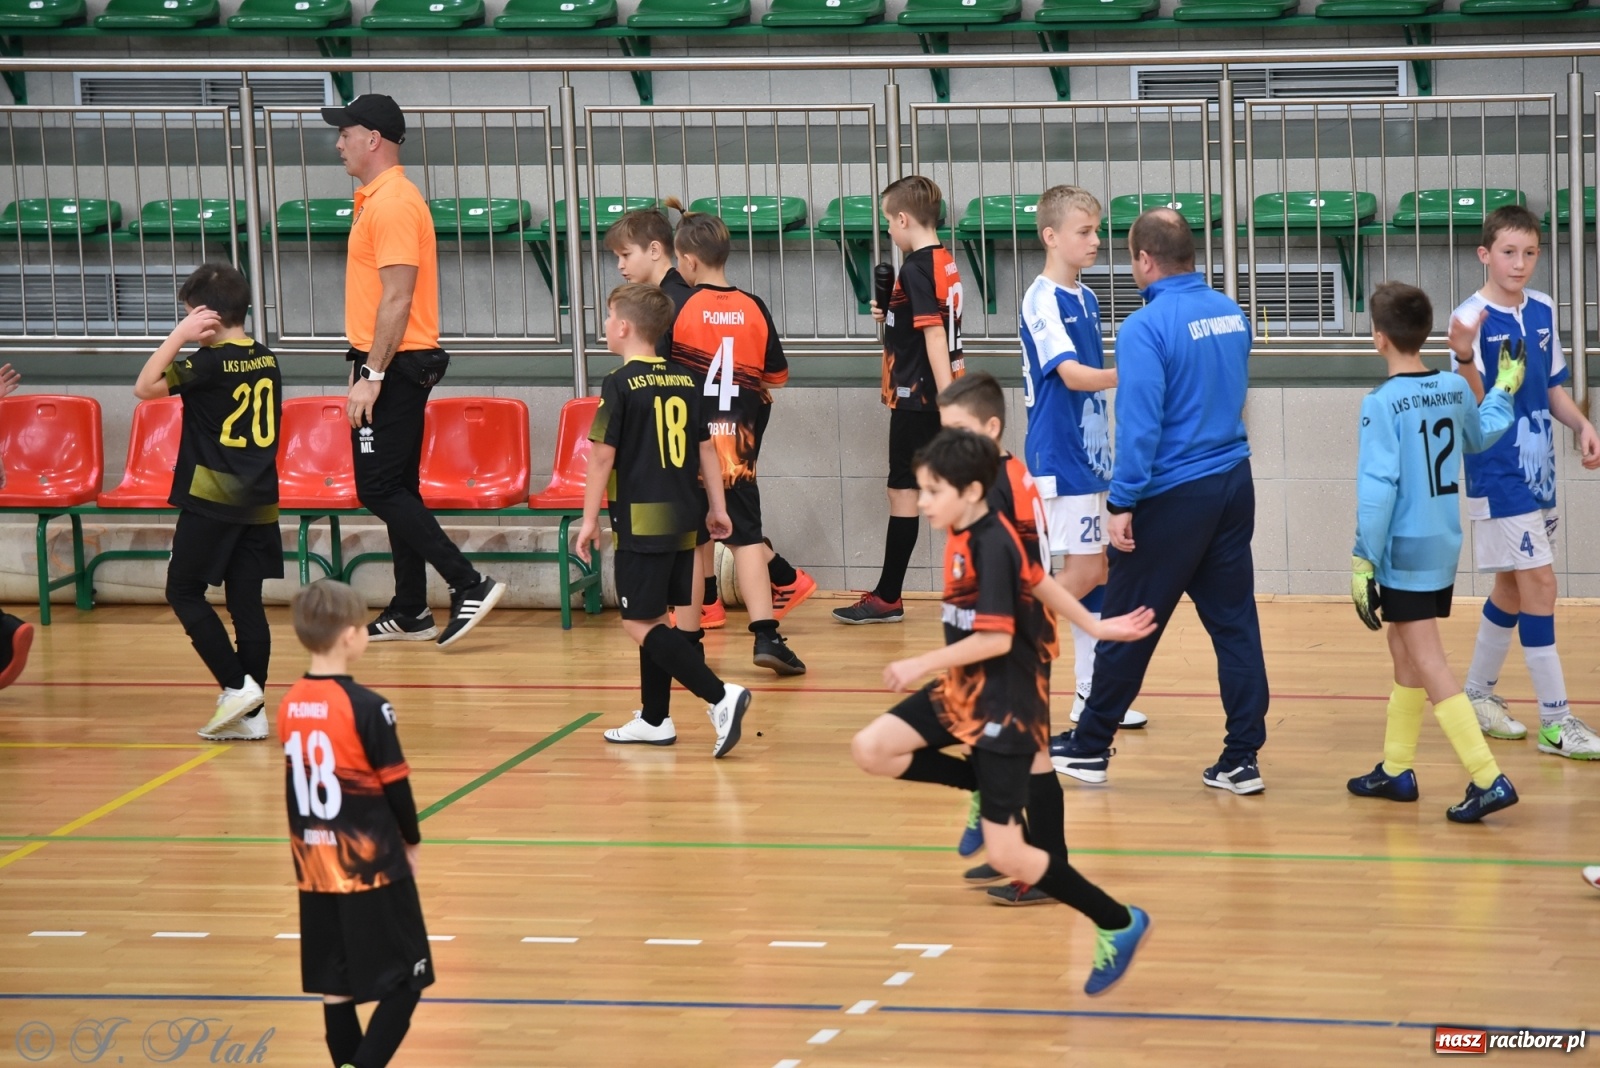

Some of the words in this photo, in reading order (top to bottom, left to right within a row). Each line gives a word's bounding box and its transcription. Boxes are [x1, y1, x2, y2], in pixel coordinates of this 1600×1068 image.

[703, 309, 745, 325] PŁOMIEŃ
[223, 359, 239, 373] LKS
[703, 336, 740, 412] 4
[627, 374, 647, 391] LKS
[219, 377, 276, 448] 20
[1391, 398, 1410, 415] LKS
[653, 395, 688, 469] 18
[360, 441, 375, 454] ML
[1418, 417, 1459, 498] 12
[1080, 515, 1102, 543] 28
[1520, 531, 1535, 558] 4
[284, 729, 343, 821] 18
[1479, 786, 1505, 808] MDS
